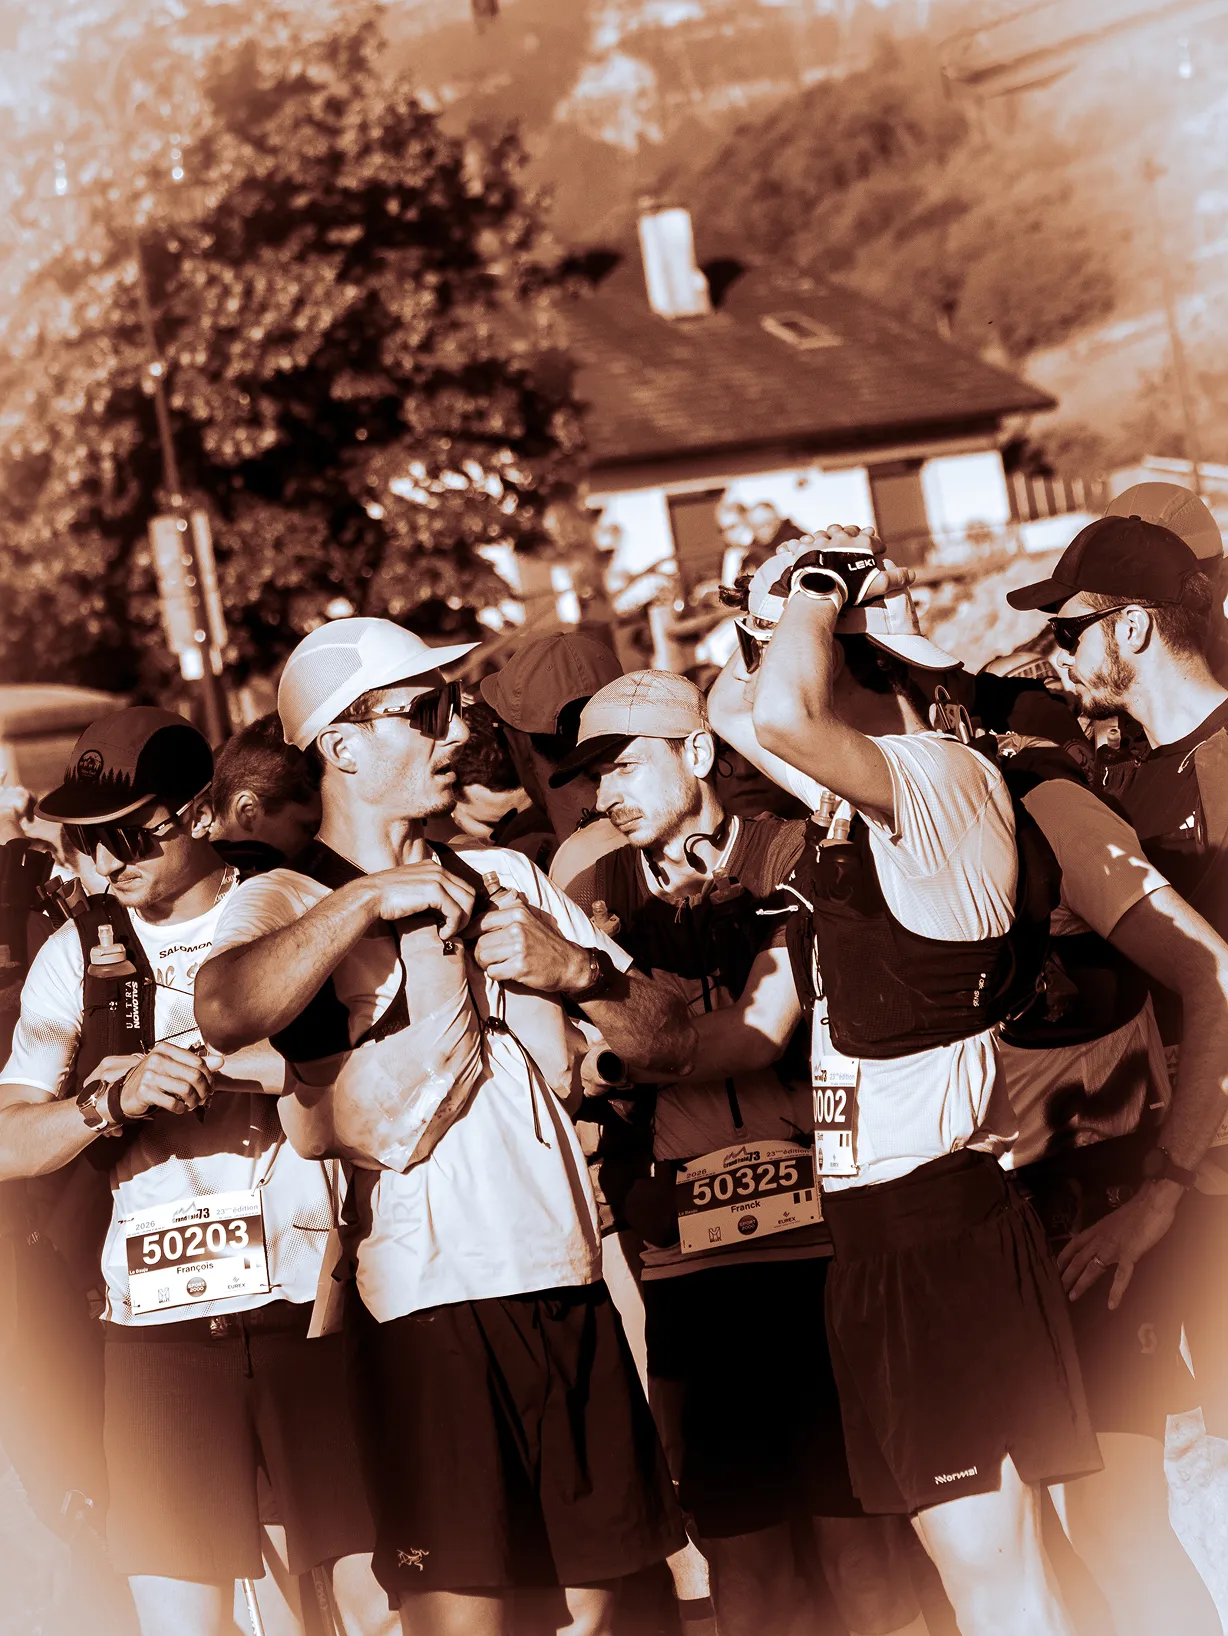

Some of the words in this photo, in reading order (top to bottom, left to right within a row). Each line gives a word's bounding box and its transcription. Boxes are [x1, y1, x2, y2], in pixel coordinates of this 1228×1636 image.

[847, 558, 876, 571] LEKI
[159, 941, 213, 958] SALOMON
[132, 981, 140, 1029] SALOMON
[783, 1148, 810, 1156] édition
[686, 1168, 707, 1179] 2026
[692, 1160, 799, 1206] 50325
[232, 1204, 259, 1213] édition
[730, 1200, 761, 1213] Franck
[135, 1220, 156, 1231] 2026
[143, 1219, 250, 1265] 50203
[176, 1261, 214, 1274] François
[227, 1282, 246, 1290] EUREX
